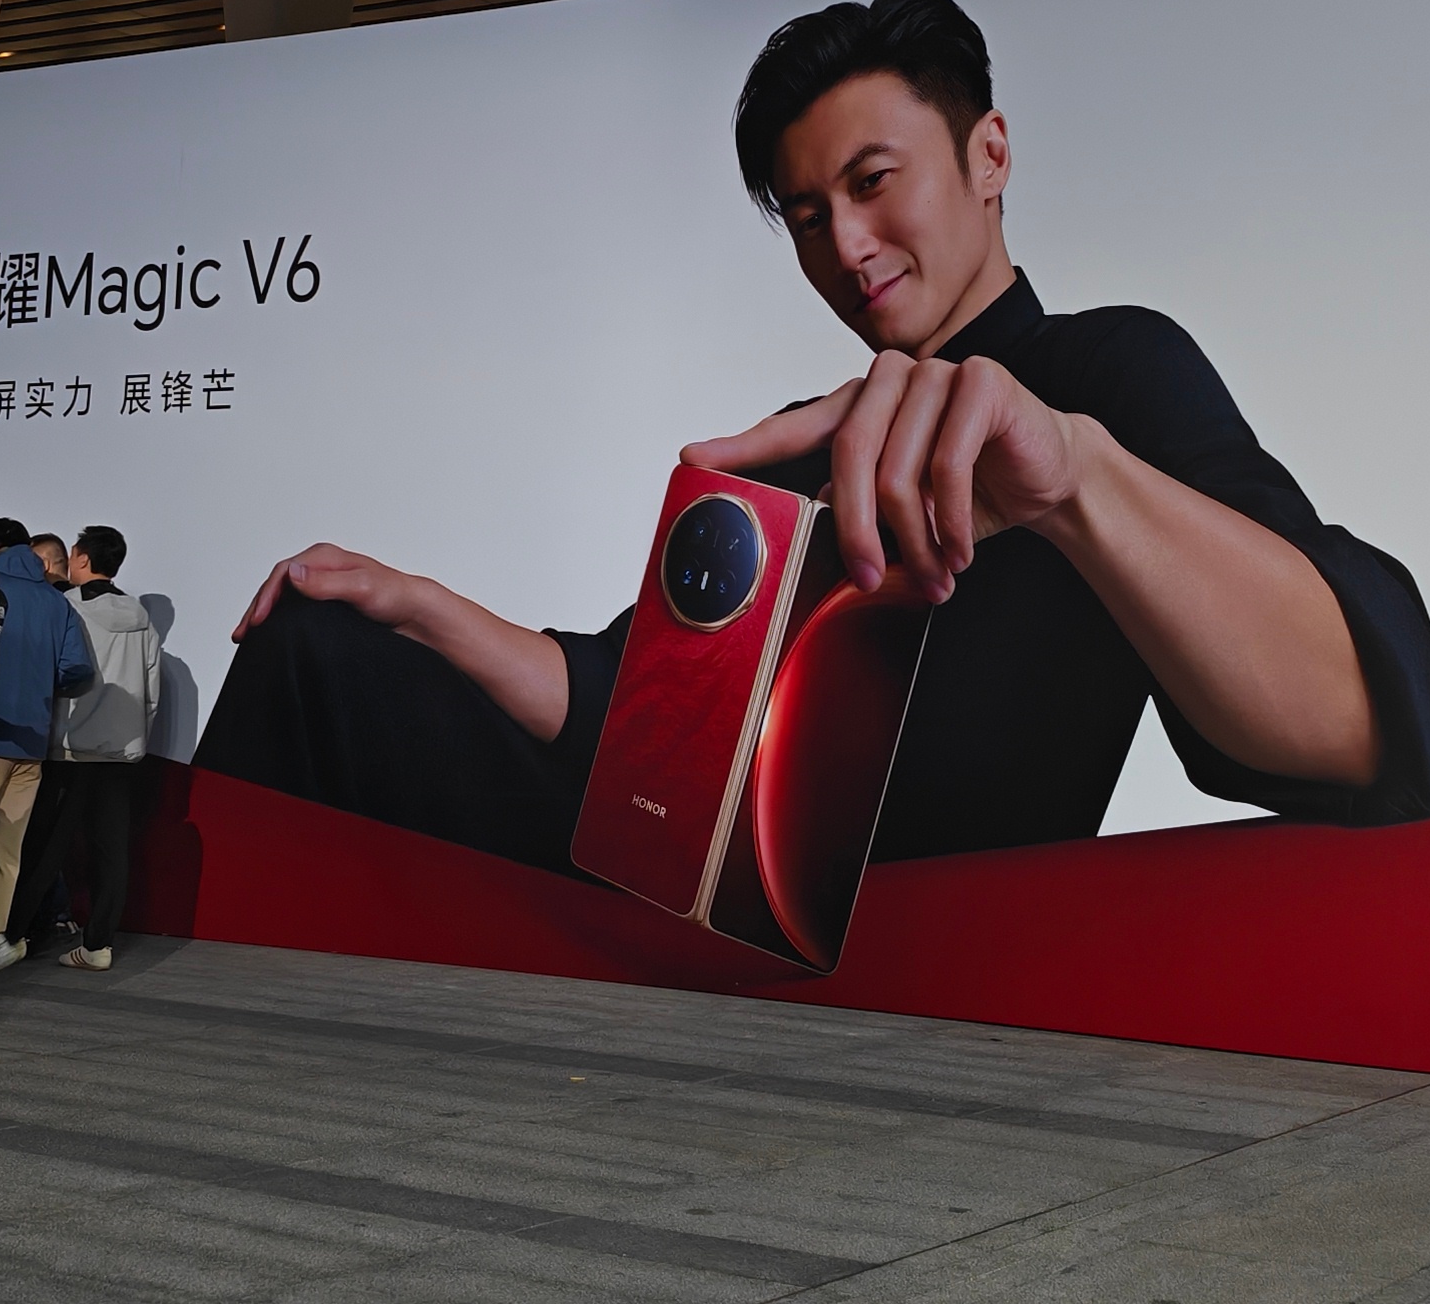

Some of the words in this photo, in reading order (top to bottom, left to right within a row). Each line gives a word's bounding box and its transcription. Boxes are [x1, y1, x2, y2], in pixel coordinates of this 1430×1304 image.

[242, 234, 321, 305] V6
[119, 368, 236, 415] 展锋芒
[631, 793, 667, 819] HONOR
